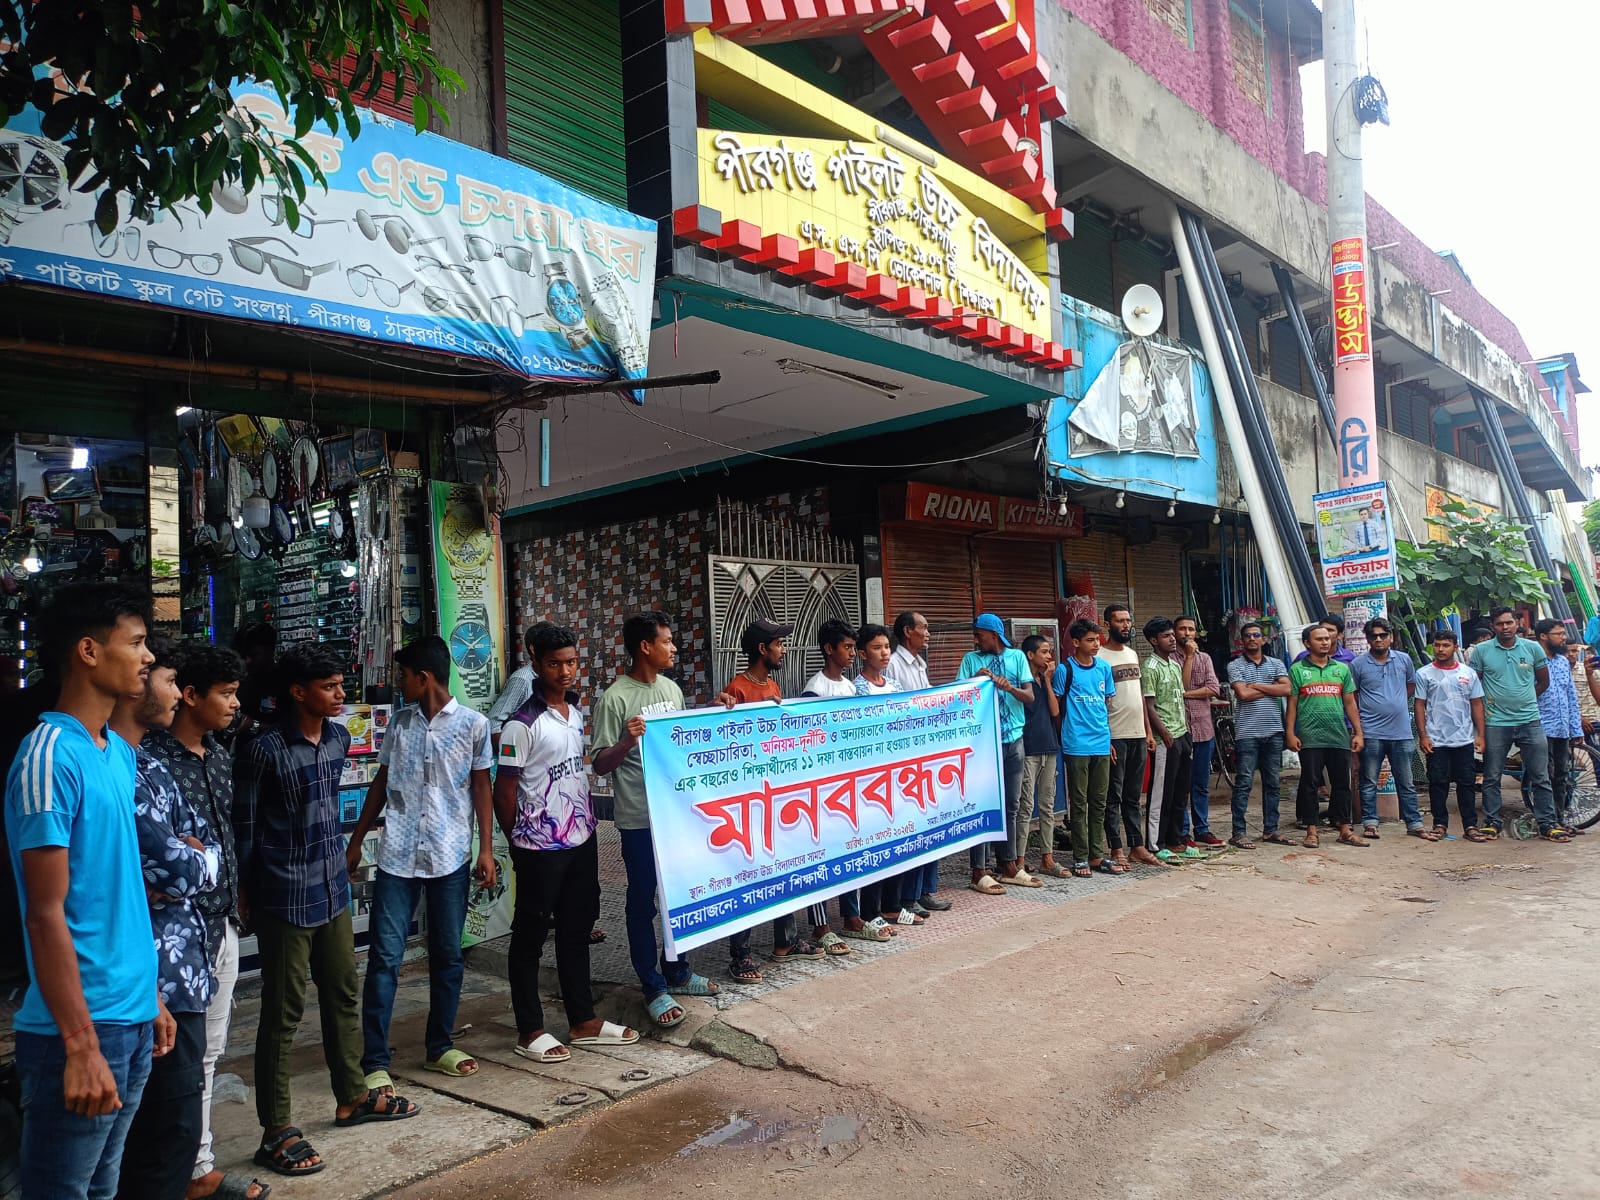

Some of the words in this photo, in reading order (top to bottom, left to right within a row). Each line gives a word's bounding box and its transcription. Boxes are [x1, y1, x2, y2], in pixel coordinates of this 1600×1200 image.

[456, 174, 574, 251] চশমা
[580, 218, 646, 282] ঘর
[714, 131, 817, 193] পীরগঞ্জ
[827, 141, 905, 198] পাইলট
[917, 166, 961, 230] উচ্চ
[971, 218, 1045, 320] বিদ্যালয়
[35, 262, 123, 291] পাইলট
[132, 278, 173, 303] স্কুল
[183, 287, 225, 310] গেট
[923, 492, 993, 525] RIONA
[1325, 559, 1389, 579] রেডিয়াস
[670, 725, 712, 747] পীরগঞ্জ
[716, 720, 754, 740] পাইলট
[756, 716, 777, 733] উচ্চ
[780, 712, 828, 732] বিদ্যালয়ের
[830, 706, 862, 723] ভারপ্রাপ্ত
[864, 703, 885, 718] প্রধান
[830, 731, 838, 742] ও
[840, 723, 884, 741] অন্যায়ভাবে
[960, 708, 976, 720] এবং
[674, 775, 697, 792] এক
[700, 768, 739, 788] বছরেও
[742, 756, 798, 781] শিক্ষার্থীদের
[801, 755, 814, 770] ১১
[816, 751, 835, 766] দফা
[838, 743, 873, 762] বাস্তবায়ন
[875, 741, 885, 753] না
[886, 736, 911, 753] হওয়ায়
[912, 734, 926, 746] তার
[693, 746, 974, 860] মানববন্ধন
[742, 880, 785, 905] সাধারণ
[789, 864, 829, 891] শিক্ষার্থী
[832, 864, 842, 876] ও
